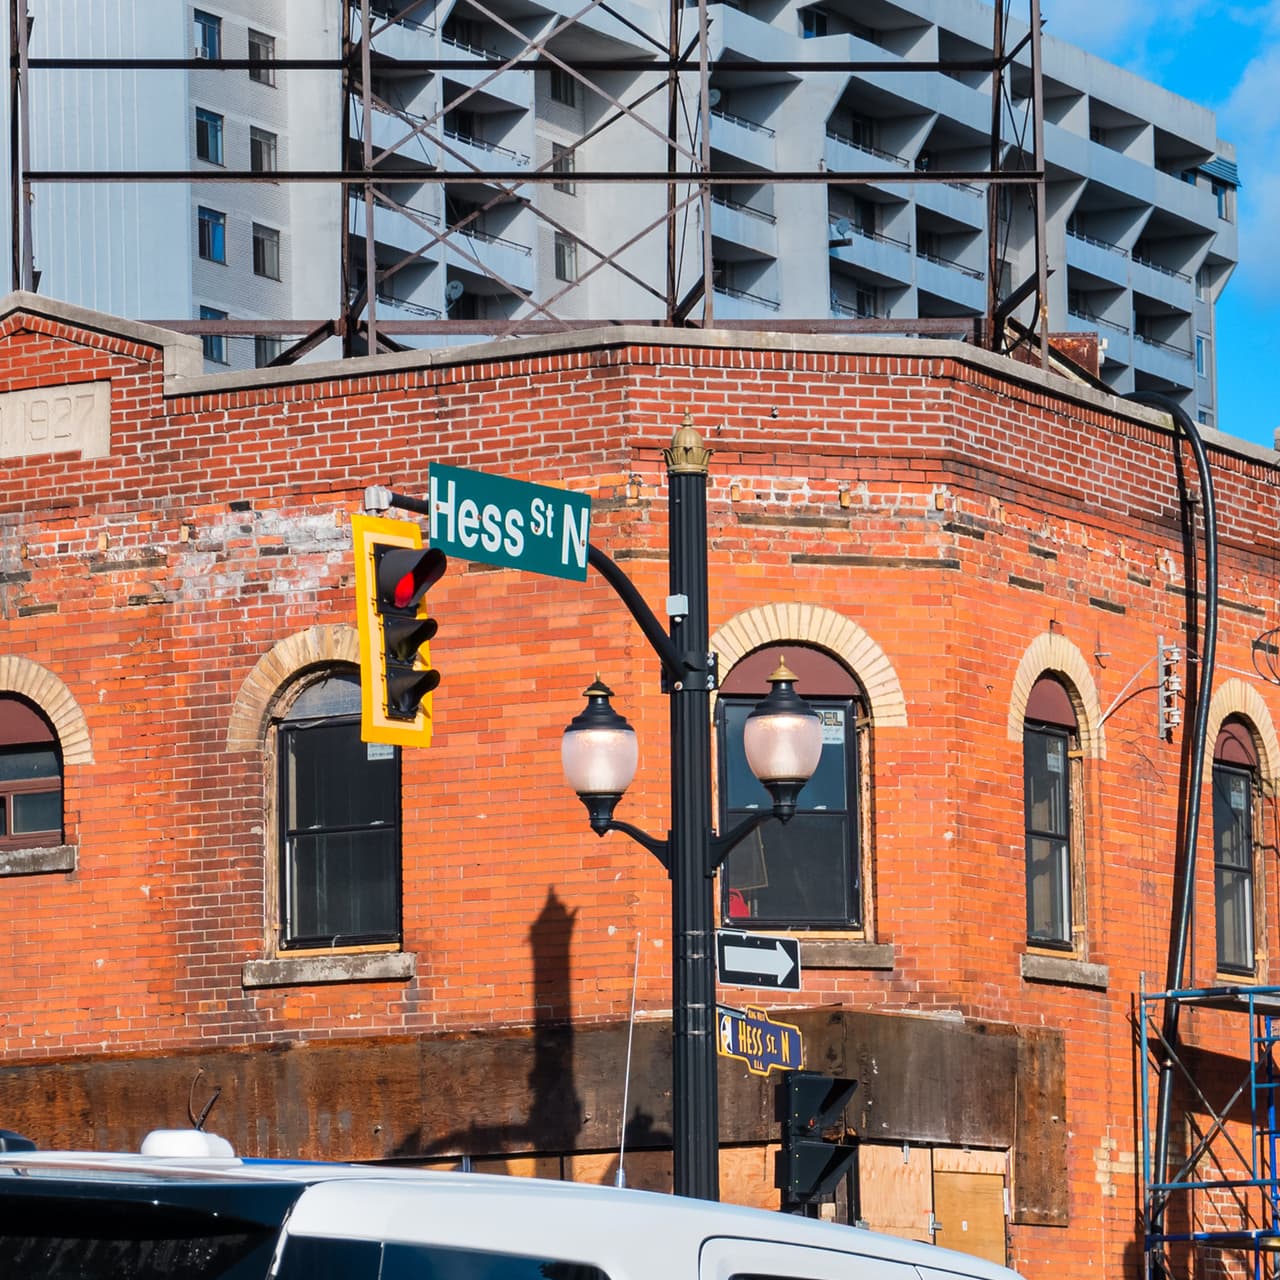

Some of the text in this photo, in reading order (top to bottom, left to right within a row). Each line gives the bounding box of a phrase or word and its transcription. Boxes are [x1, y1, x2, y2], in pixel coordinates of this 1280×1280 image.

[429, 476, 588, 568] Hess St N
[738, 1020, 790, 1064] HESS ST. N
